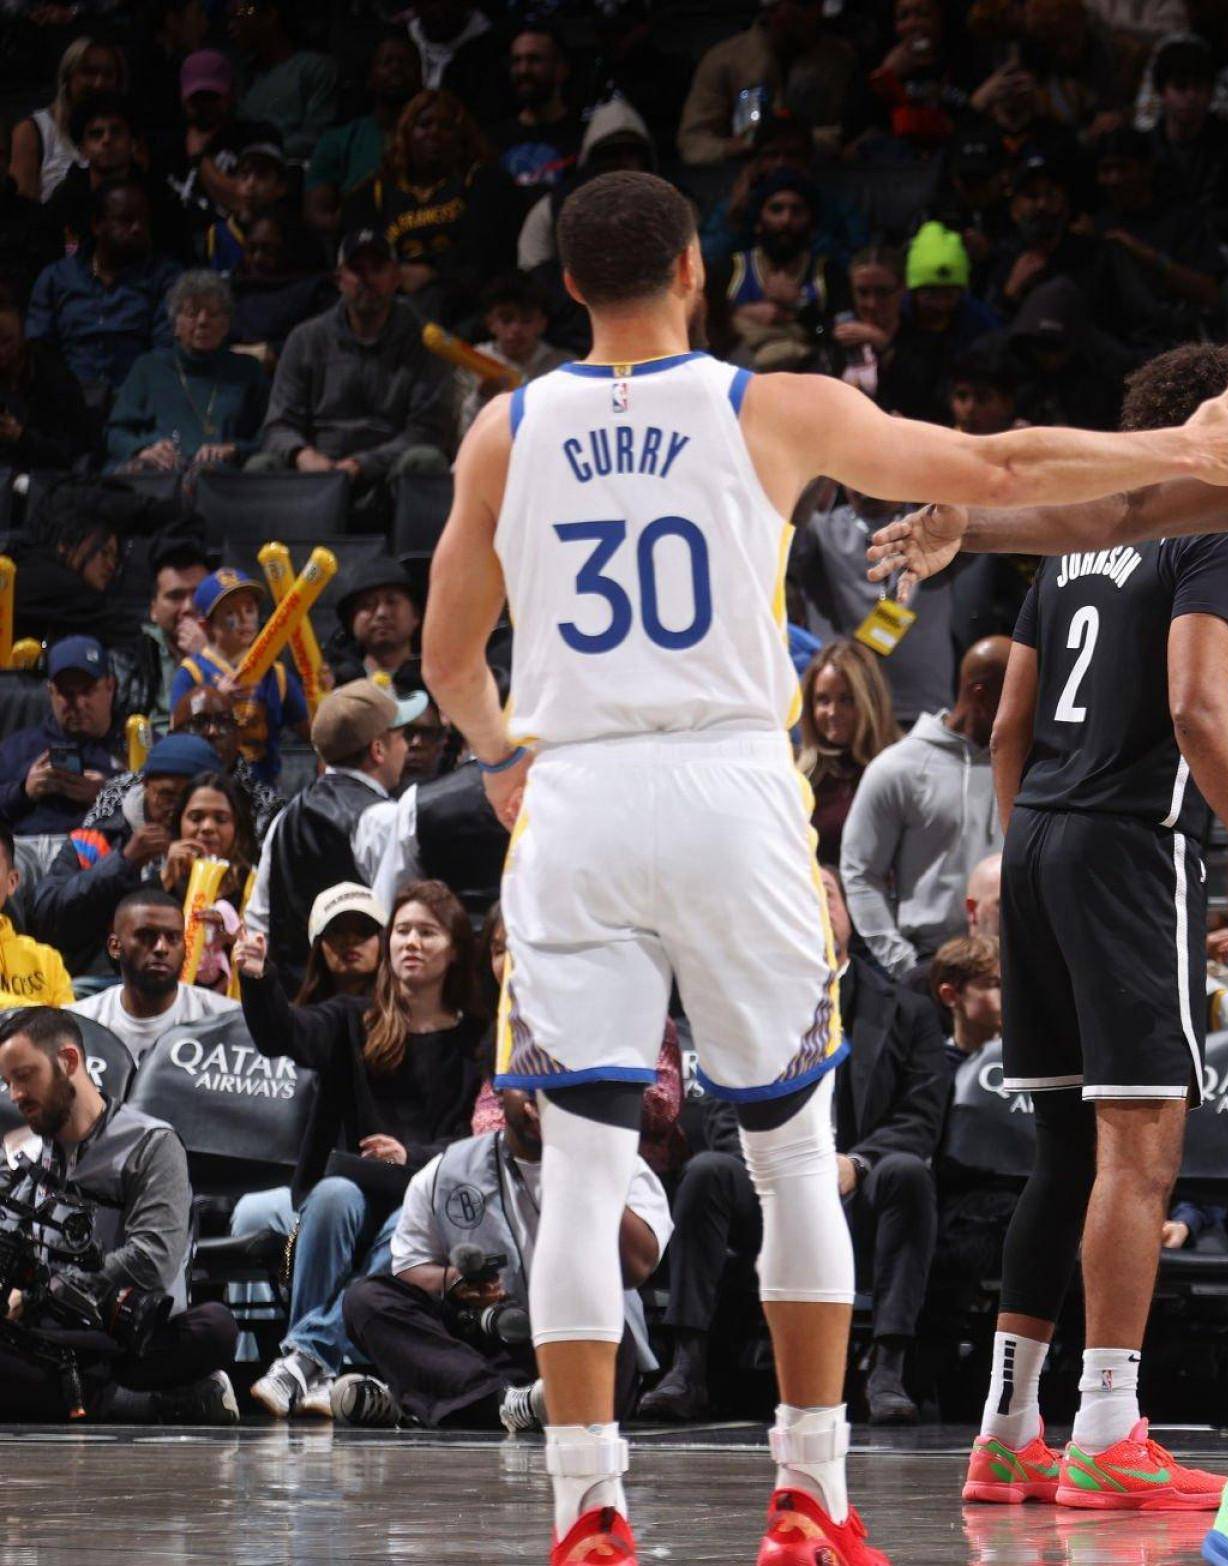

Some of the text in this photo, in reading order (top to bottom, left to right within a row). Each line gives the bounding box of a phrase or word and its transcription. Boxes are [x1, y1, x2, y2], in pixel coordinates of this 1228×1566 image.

[563, 426, 690, 483] CURRY
[552, 516, 713, 654] 30
[1054, 605, 1099, 722] 2
[170, 1037, 298, 1080] QATAR
[194, 1072, 296, 1100] AIRWAYS
